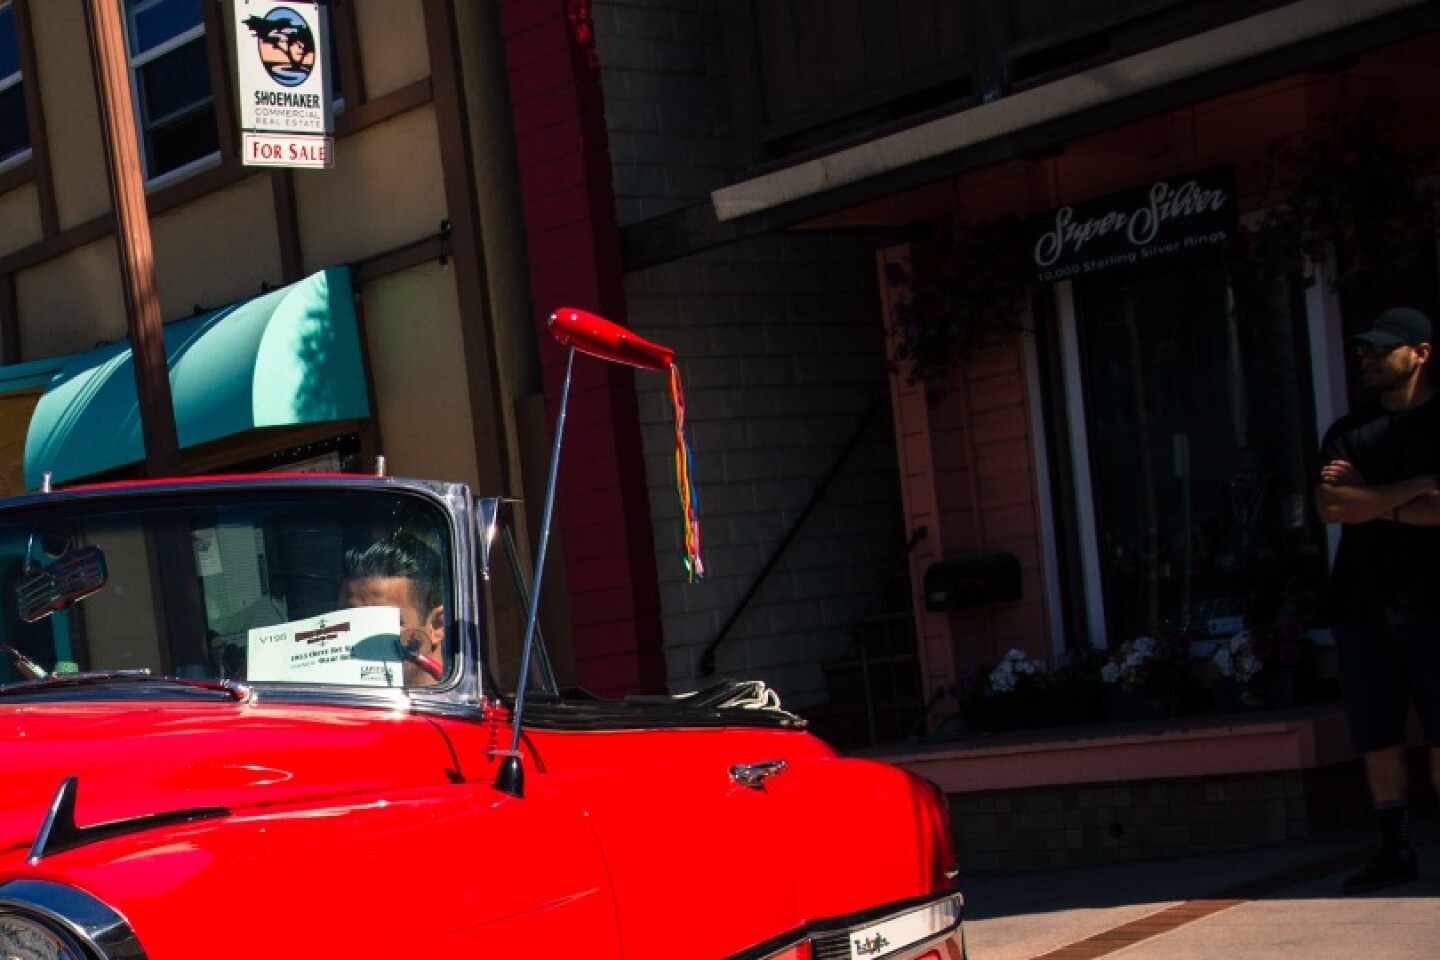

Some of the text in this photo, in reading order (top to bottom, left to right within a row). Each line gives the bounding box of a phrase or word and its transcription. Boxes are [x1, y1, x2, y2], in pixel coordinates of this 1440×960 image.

[254, 90, 320, 109] SHOEMAKER
[254, 108, 320, 120] COMMERCIAL
[255, 117, 320, 129] REAL ESTATE
[253, 141, 326, 161] FOR SALE
[1034, 180, 1227, 266] Super Silver
[1084, 252, 1136, 271] Sterling
[1141, 241, 1179, 258] Silver
[1183, 230, 1227, 247] Rings
